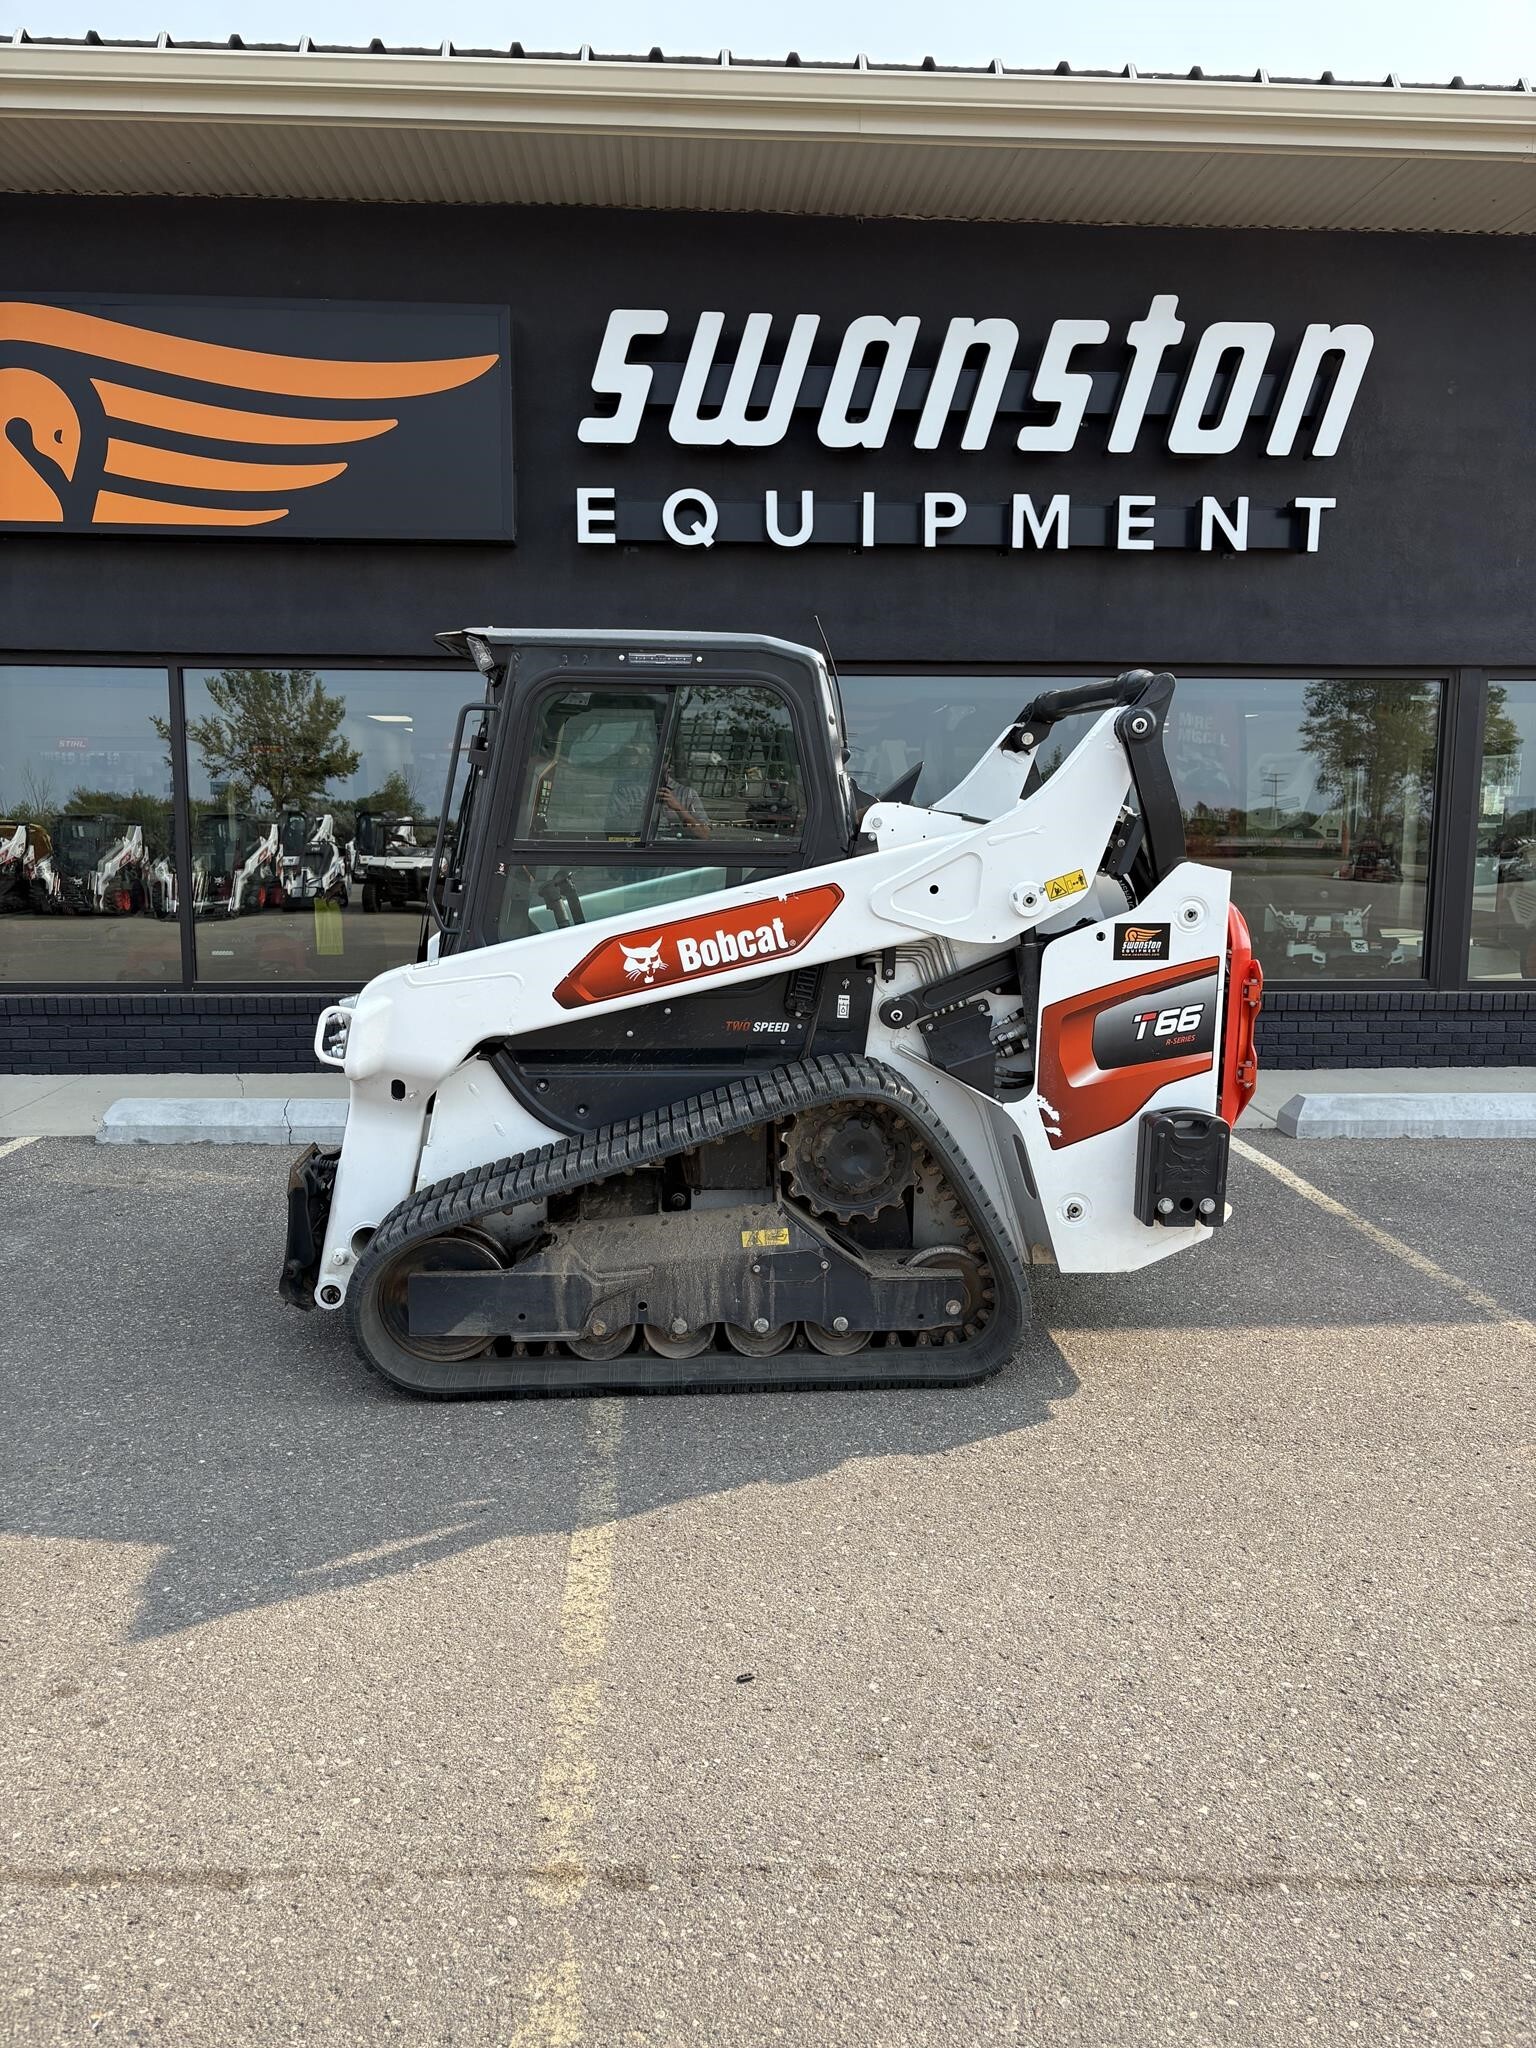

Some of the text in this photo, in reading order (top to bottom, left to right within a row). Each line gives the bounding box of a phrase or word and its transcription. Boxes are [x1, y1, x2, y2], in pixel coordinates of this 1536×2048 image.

[576, 487, 1337, 553] EQUIPMENT
[725, 1020, 790, 1033] TWO SPEED
[1132, 1003, 1205, 1041] T66
[1165, 1034, 1197, 1046] R-SERIES
